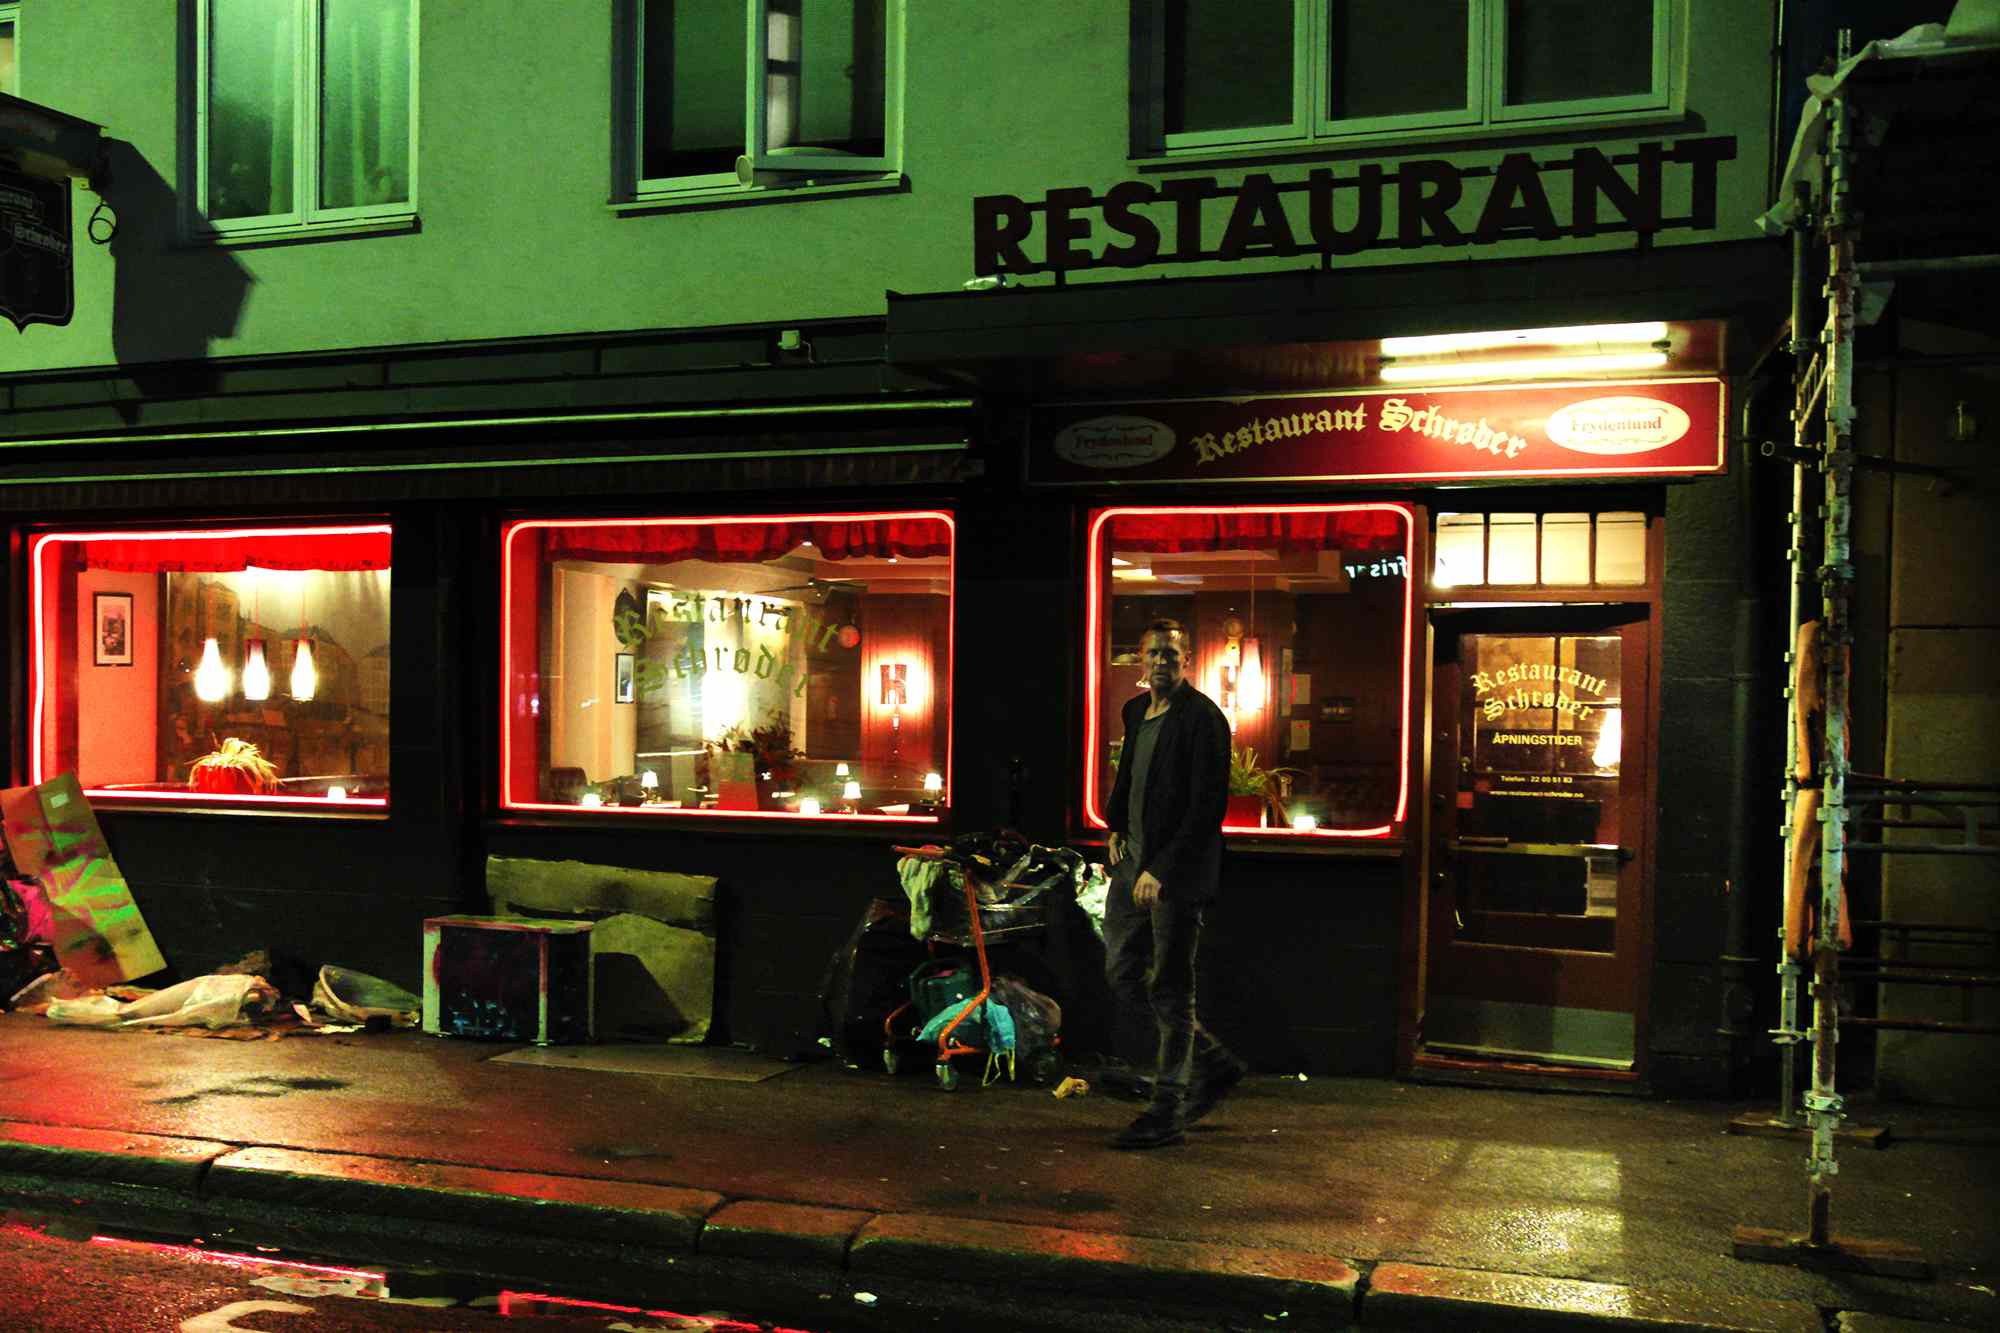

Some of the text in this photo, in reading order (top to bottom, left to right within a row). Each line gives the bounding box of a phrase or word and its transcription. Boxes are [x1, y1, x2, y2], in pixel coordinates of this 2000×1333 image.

[973, 136, 1737, 277] RESTAURANT
[1190, 400, 1368, 465] Restaurant
[1470, 662, 1608, 697] Restaurant
[1483, 687, 1595, 722] Schrøder
[1492, 732, 1583, 746] ÅPNINGSTIDER
